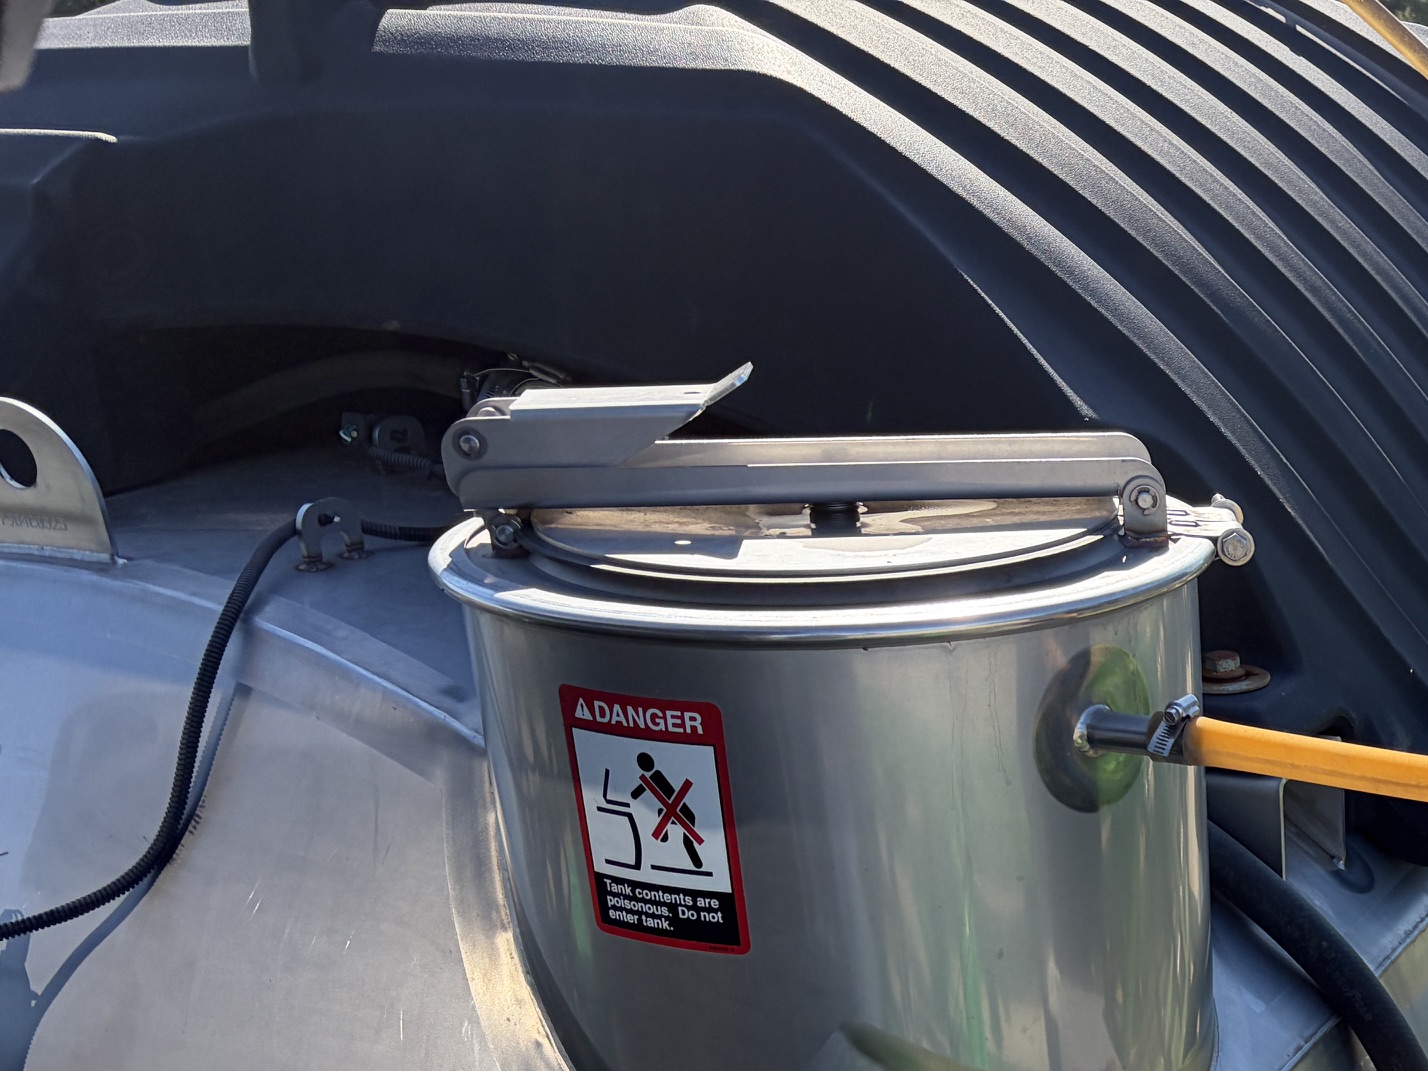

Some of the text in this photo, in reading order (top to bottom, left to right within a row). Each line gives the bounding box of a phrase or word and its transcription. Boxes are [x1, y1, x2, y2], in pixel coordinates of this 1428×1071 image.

[593, 700, 704, 735] DANGER
[603, 878, 719, 909] Tank contents are
[607, 895, 724, 924] poisonous. Do not
[609, 909, 674, 931] enter tank.
